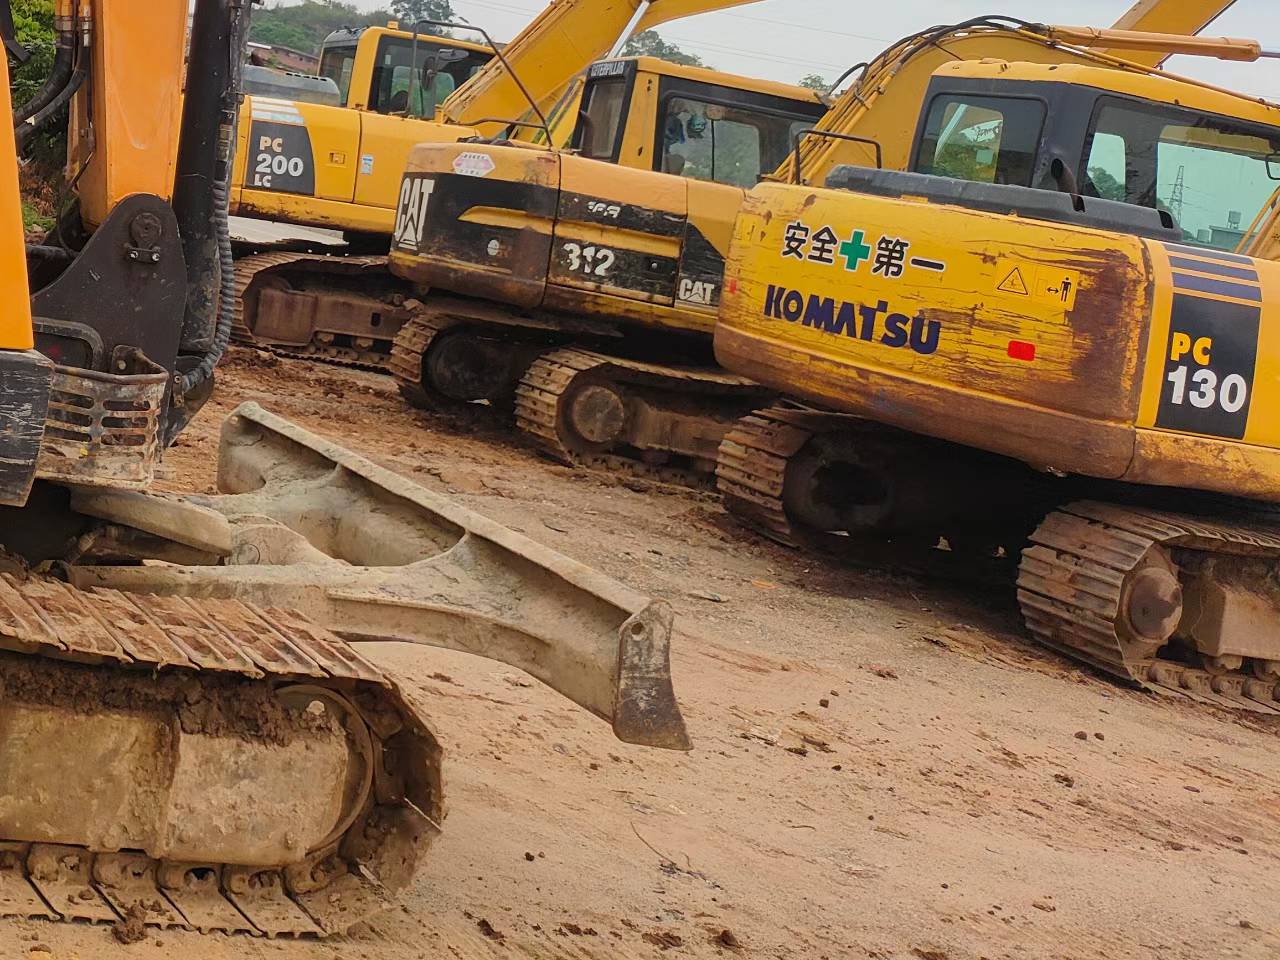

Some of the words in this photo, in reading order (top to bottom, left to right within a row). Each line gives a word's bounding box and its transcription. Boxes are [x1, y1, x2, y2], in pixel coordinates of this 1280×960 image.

[259, 135, 283, 153] PC
[253, 173, 272, 188] LC
[255, 153, 304, 177] 200
[394, 177, 435, 248] CAT
[562, 242, 615, 277] 312
[678, 278, 715, 305] CAT
[763, 283, 942, 355] KOMATSU
[1170, 332, 1213, 366] PC
[1167, 365, 1248, 414] 130
